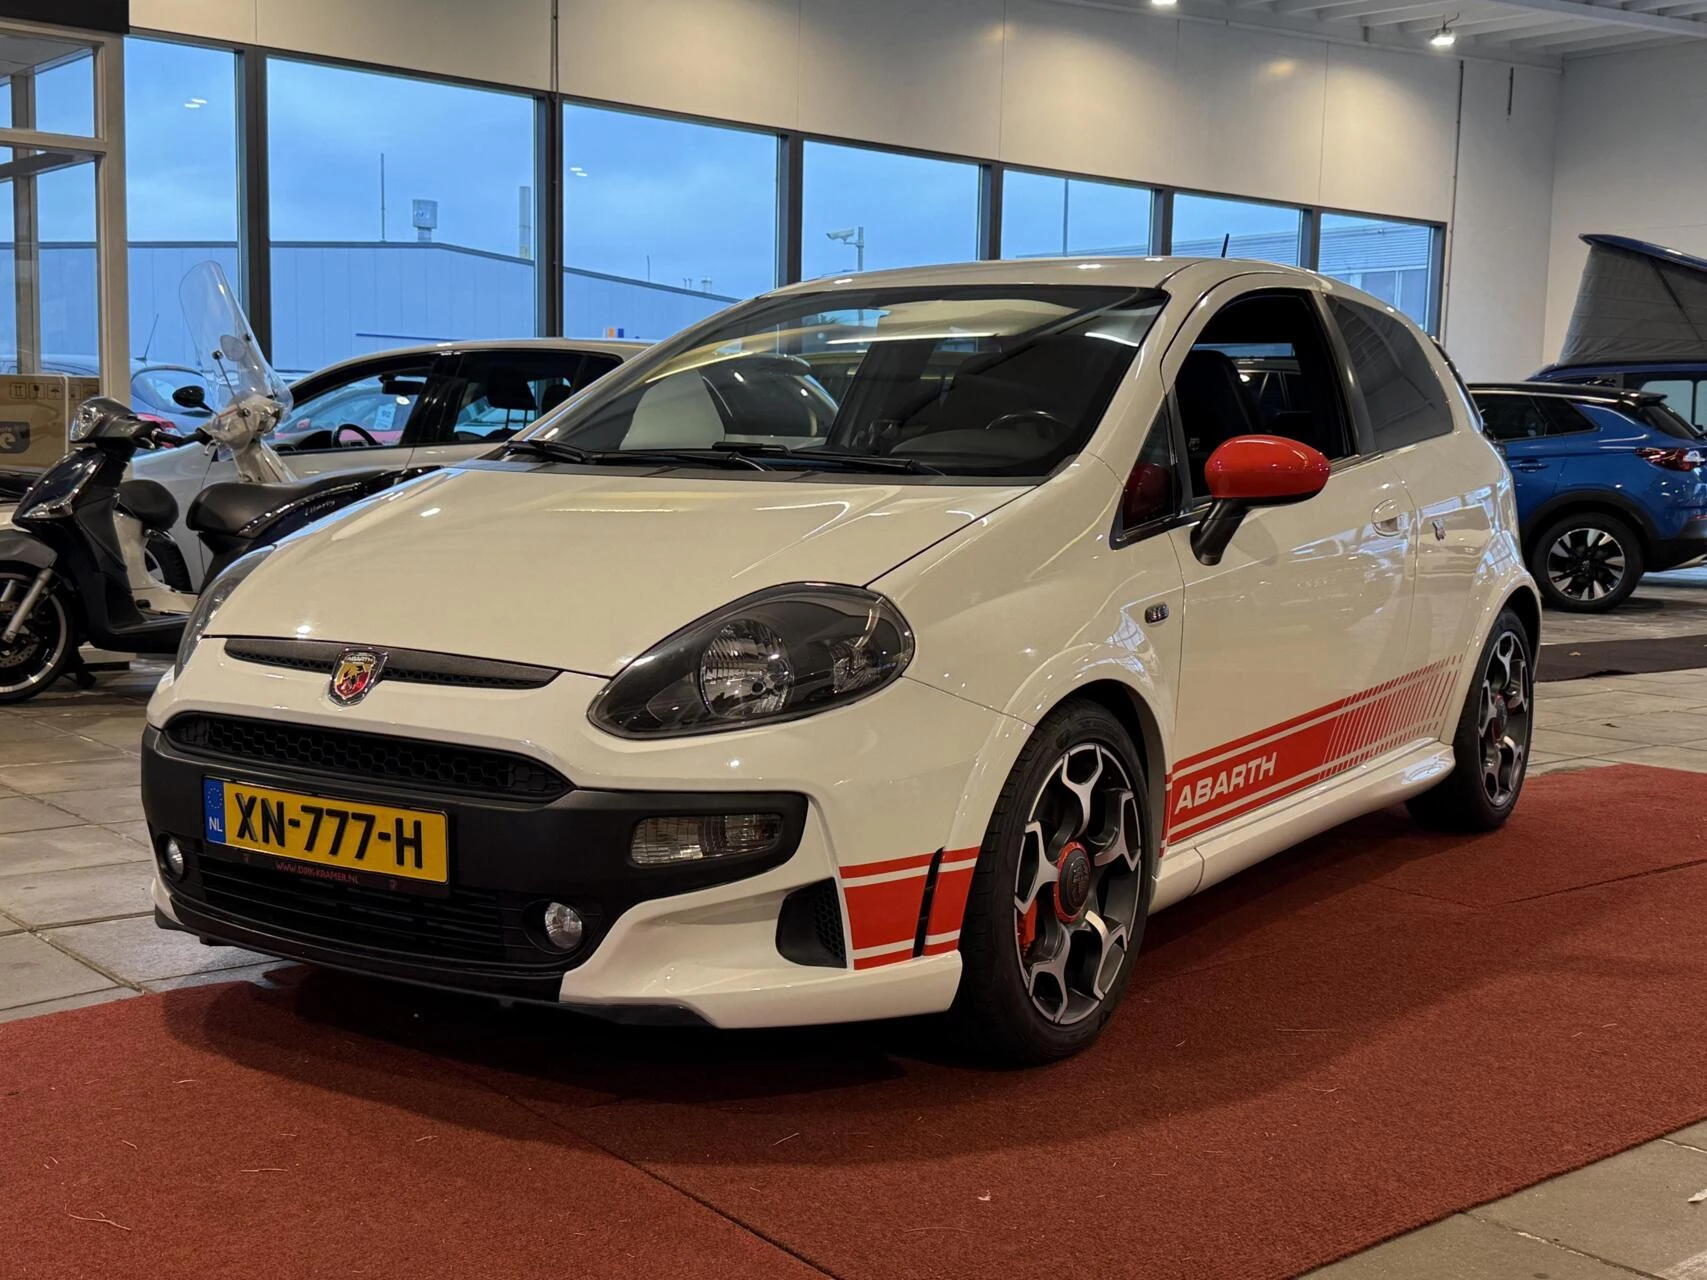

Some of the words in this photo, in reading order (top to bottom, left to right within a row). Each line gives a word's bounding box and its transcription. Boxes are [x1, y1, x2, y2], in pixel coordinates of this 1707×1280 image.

[1174, 751, 1278, 815] ABARTH
[208, 816, 224, 832] NL
[235, 792, 423, 869] XN-777-H
